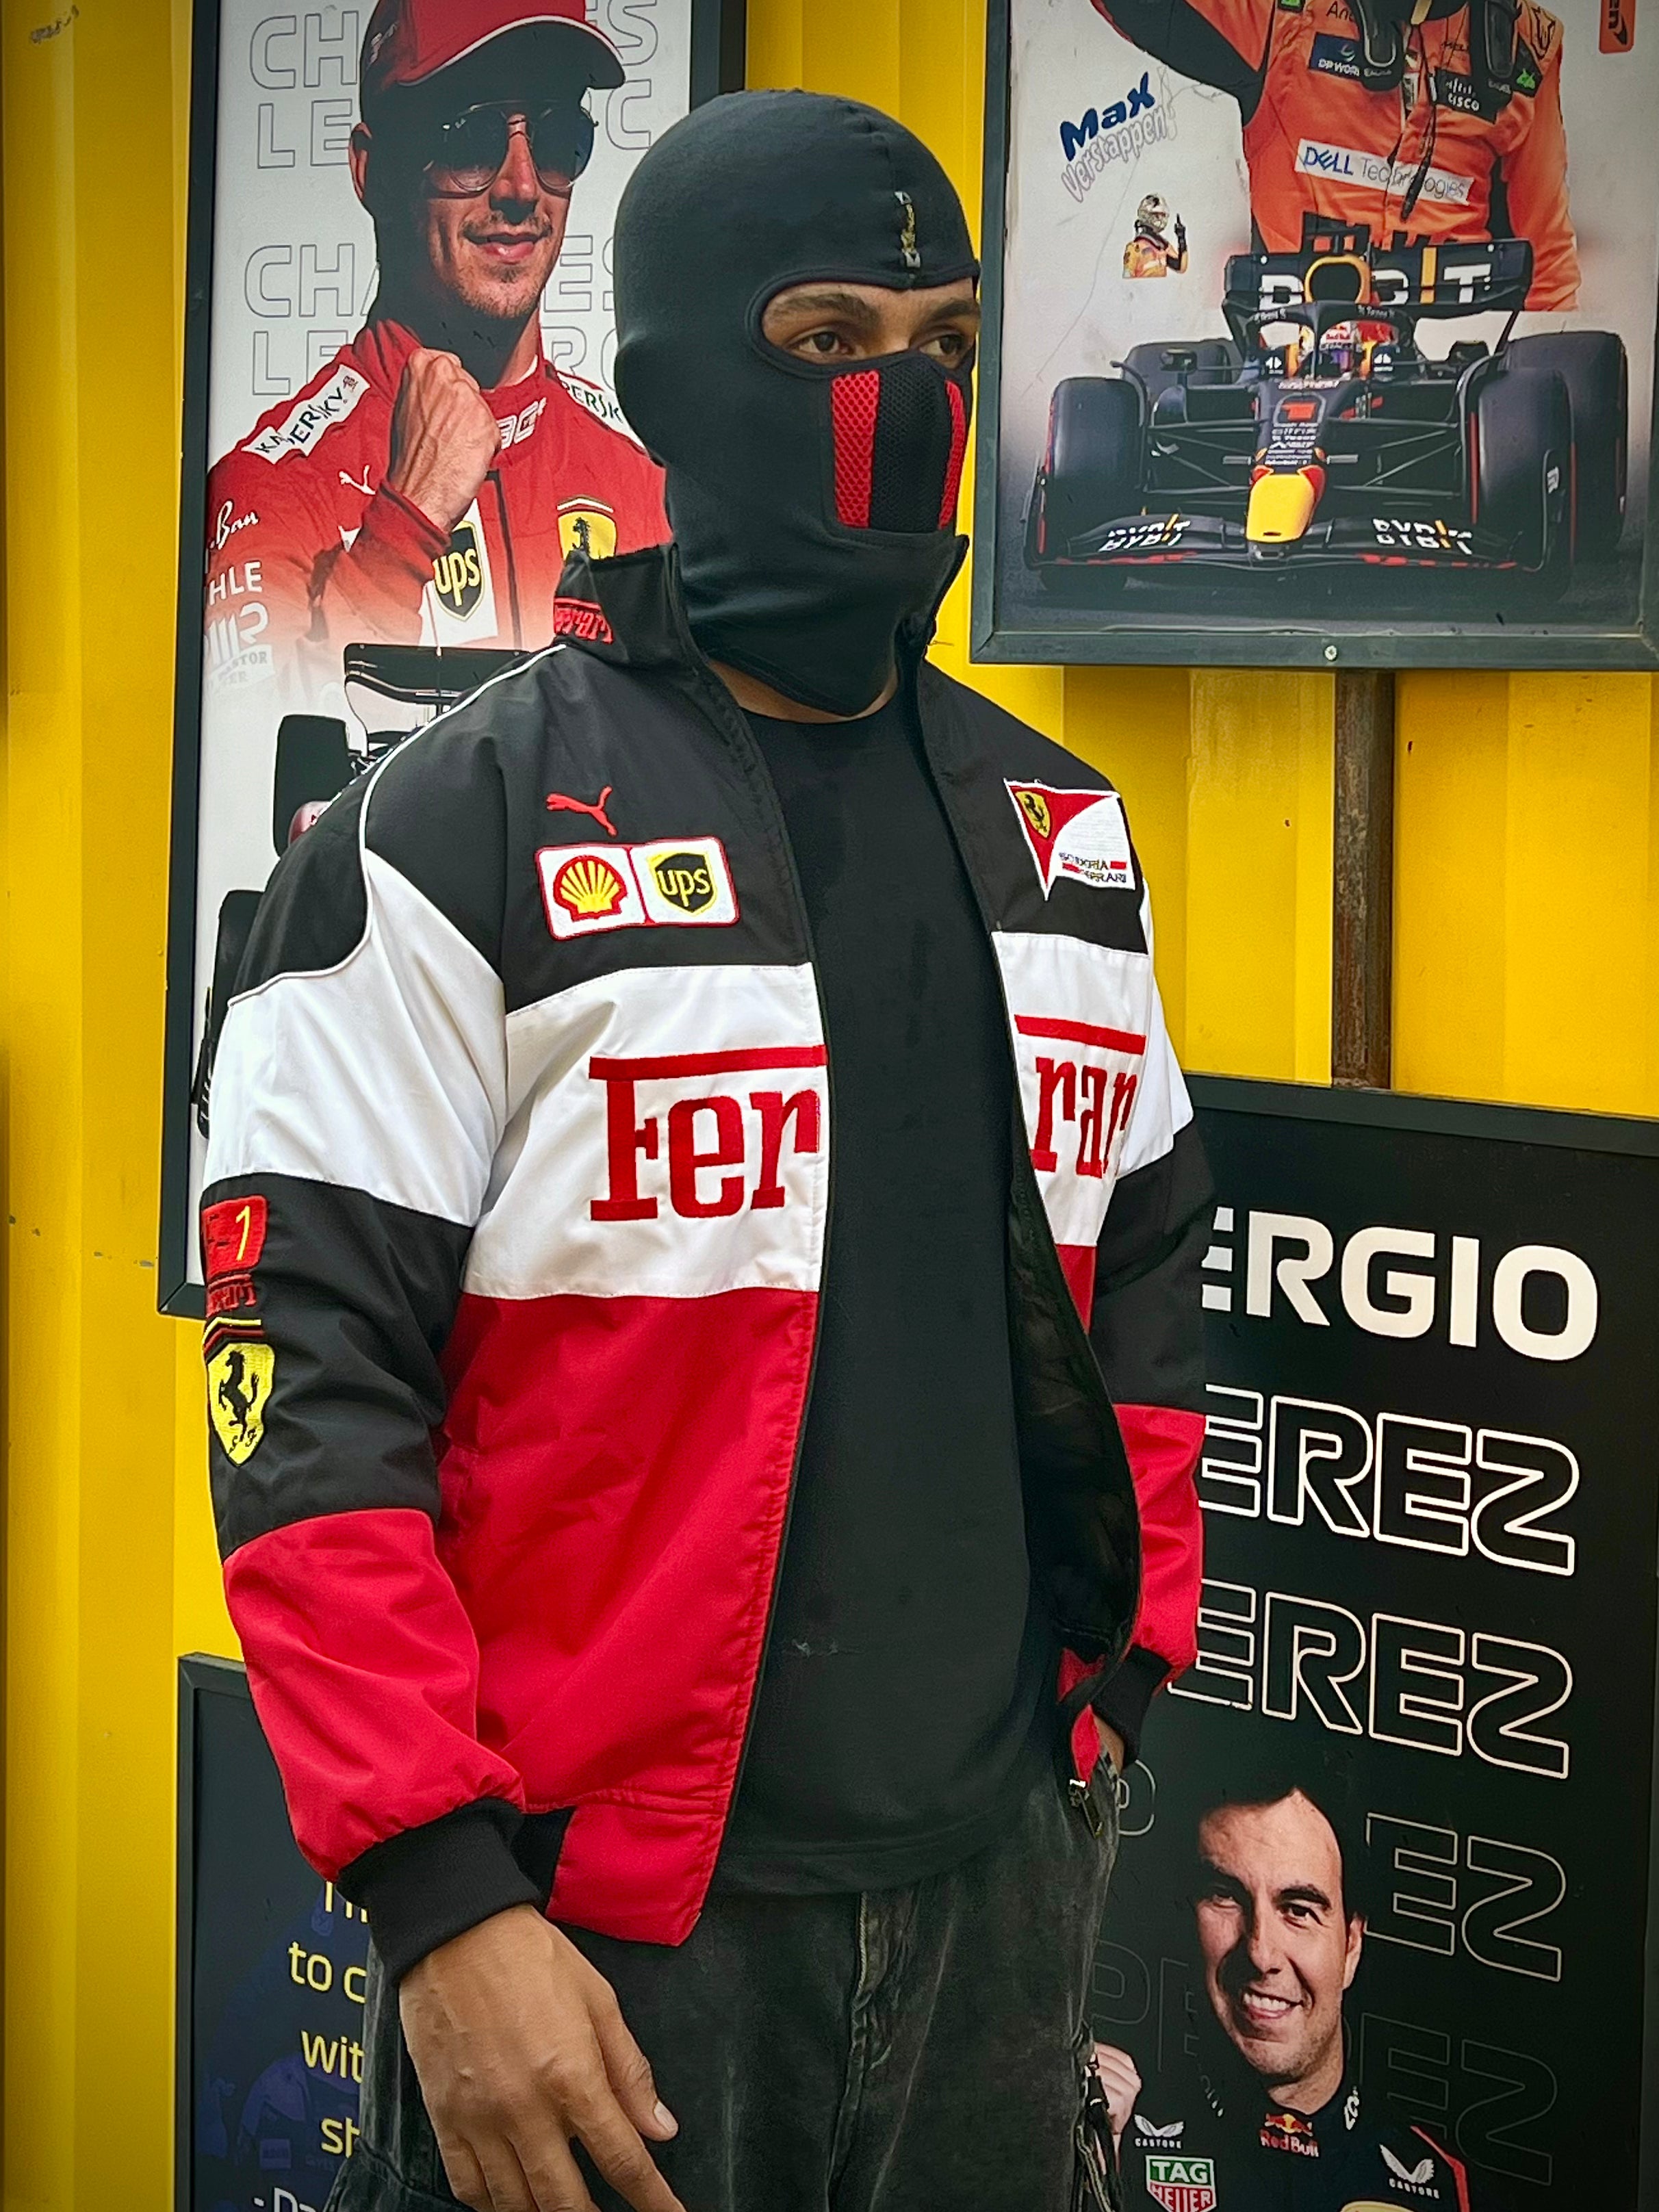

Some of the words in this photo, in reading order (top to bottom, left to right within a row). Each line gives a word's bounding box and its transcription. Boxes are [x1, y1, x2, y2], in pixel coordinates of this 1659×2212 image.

[1060, 71, 1155, 162] Max
[1062, 105, 1168, 203] Verstappen
[1303, 146, 1354, 176] DELL
[657, 869, 710, 907] ups
[589, 1044, 829, 1222] Fer
[288, 1940, 333, 1992] to
[301, 2030, 365, 2084] wit
[1134, 2137, 1182, 2149] CASTORE
[1151, 2160, 1209, 2184] TAG
